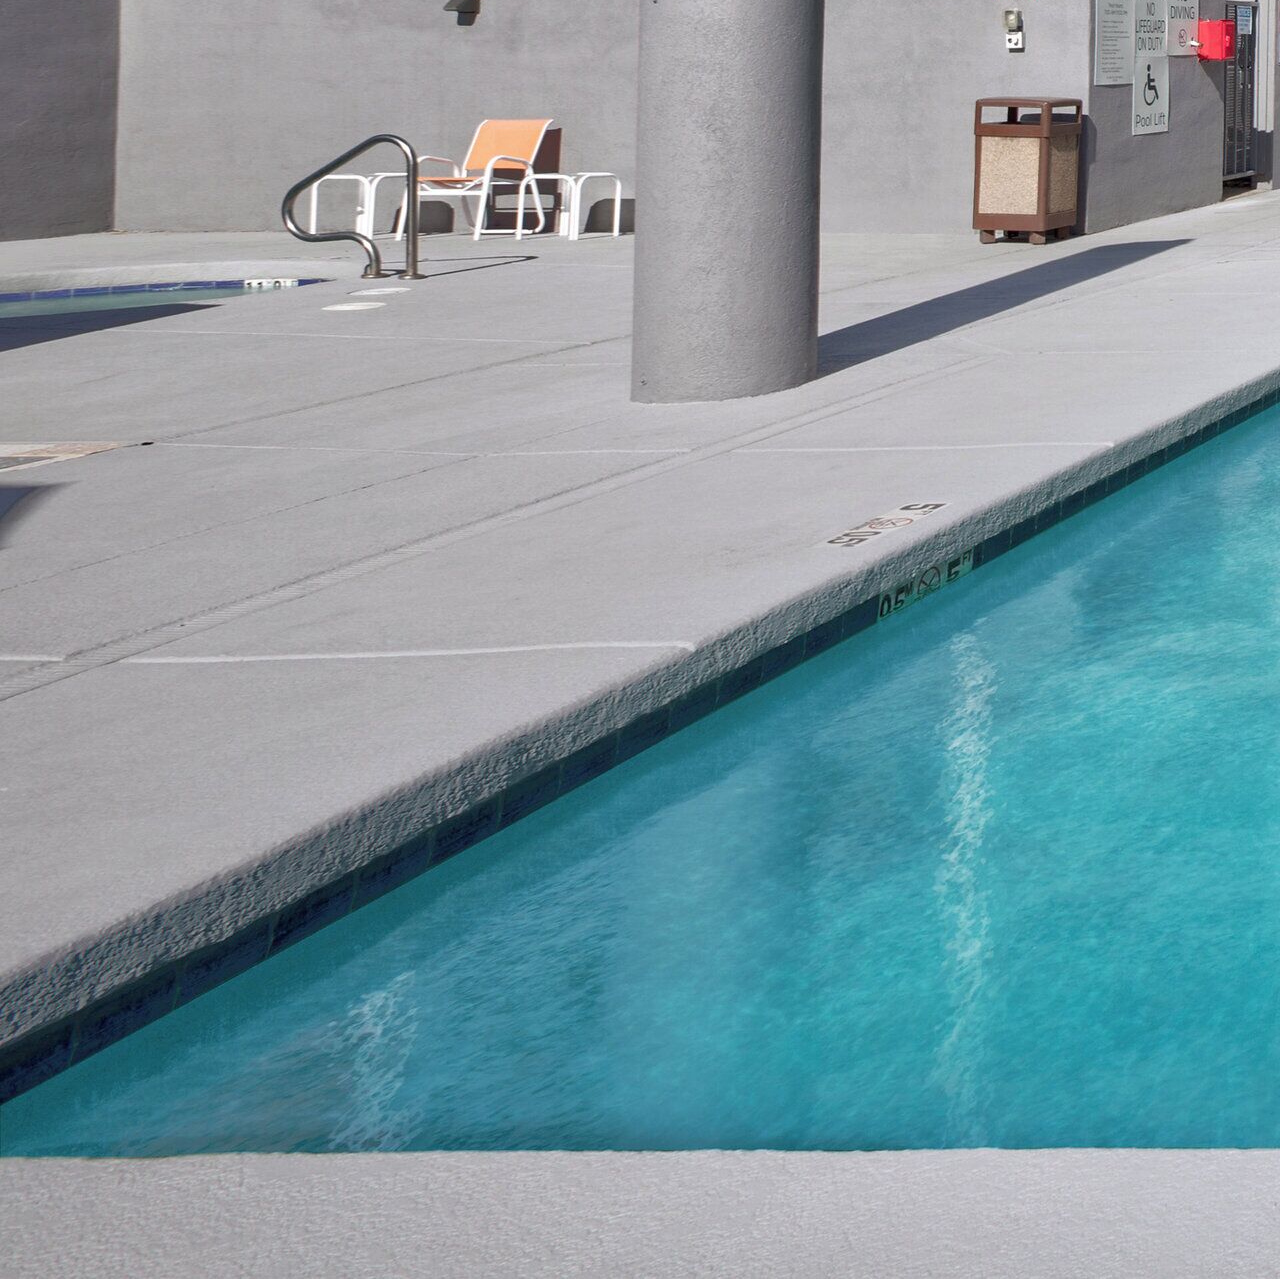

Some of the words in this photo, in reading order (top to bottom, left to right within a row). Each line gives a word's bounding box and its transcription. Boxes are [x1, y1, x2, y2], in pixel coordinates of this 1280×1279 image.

[1146, 2, 1155, 16] NO
[1170, 5, 1195, 19] DIVING
[1135, 19, 1166, 33] LIFEGUARD
[1137, 37, 1147, 50] ON
[1148, 37, 1163, 50] DUTY
[1135, 114, 1152, 127] Pool
[1154, 112, 1166, 126] Lift
